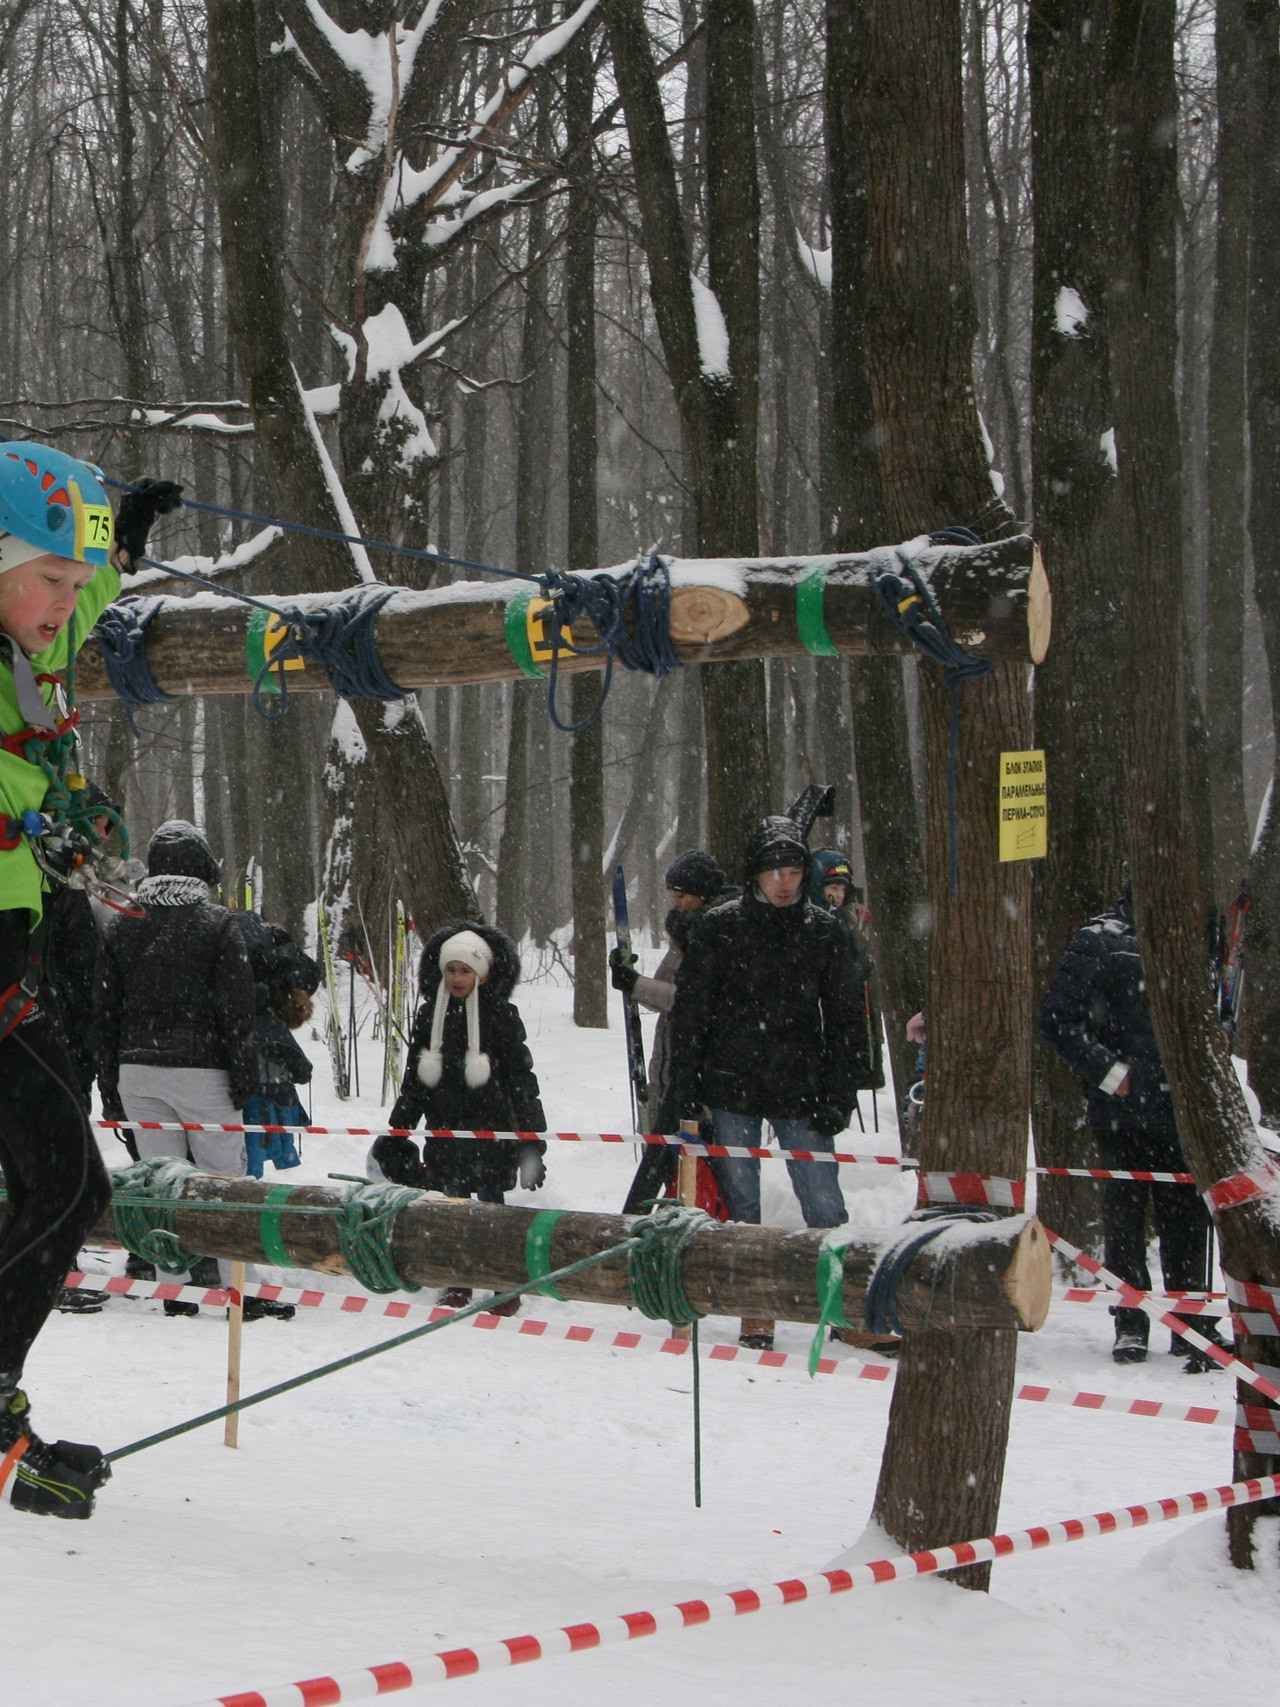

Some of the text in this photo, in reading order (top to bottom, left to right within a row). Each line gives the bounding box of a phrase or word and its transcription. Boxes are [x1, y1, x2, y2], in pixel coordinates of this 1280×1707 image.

[88, 515, 110, 542] 75
[532, 604, 567, 651] 1
[1005, 760, 1043, 775] БЛОК ЭТАПОВ
